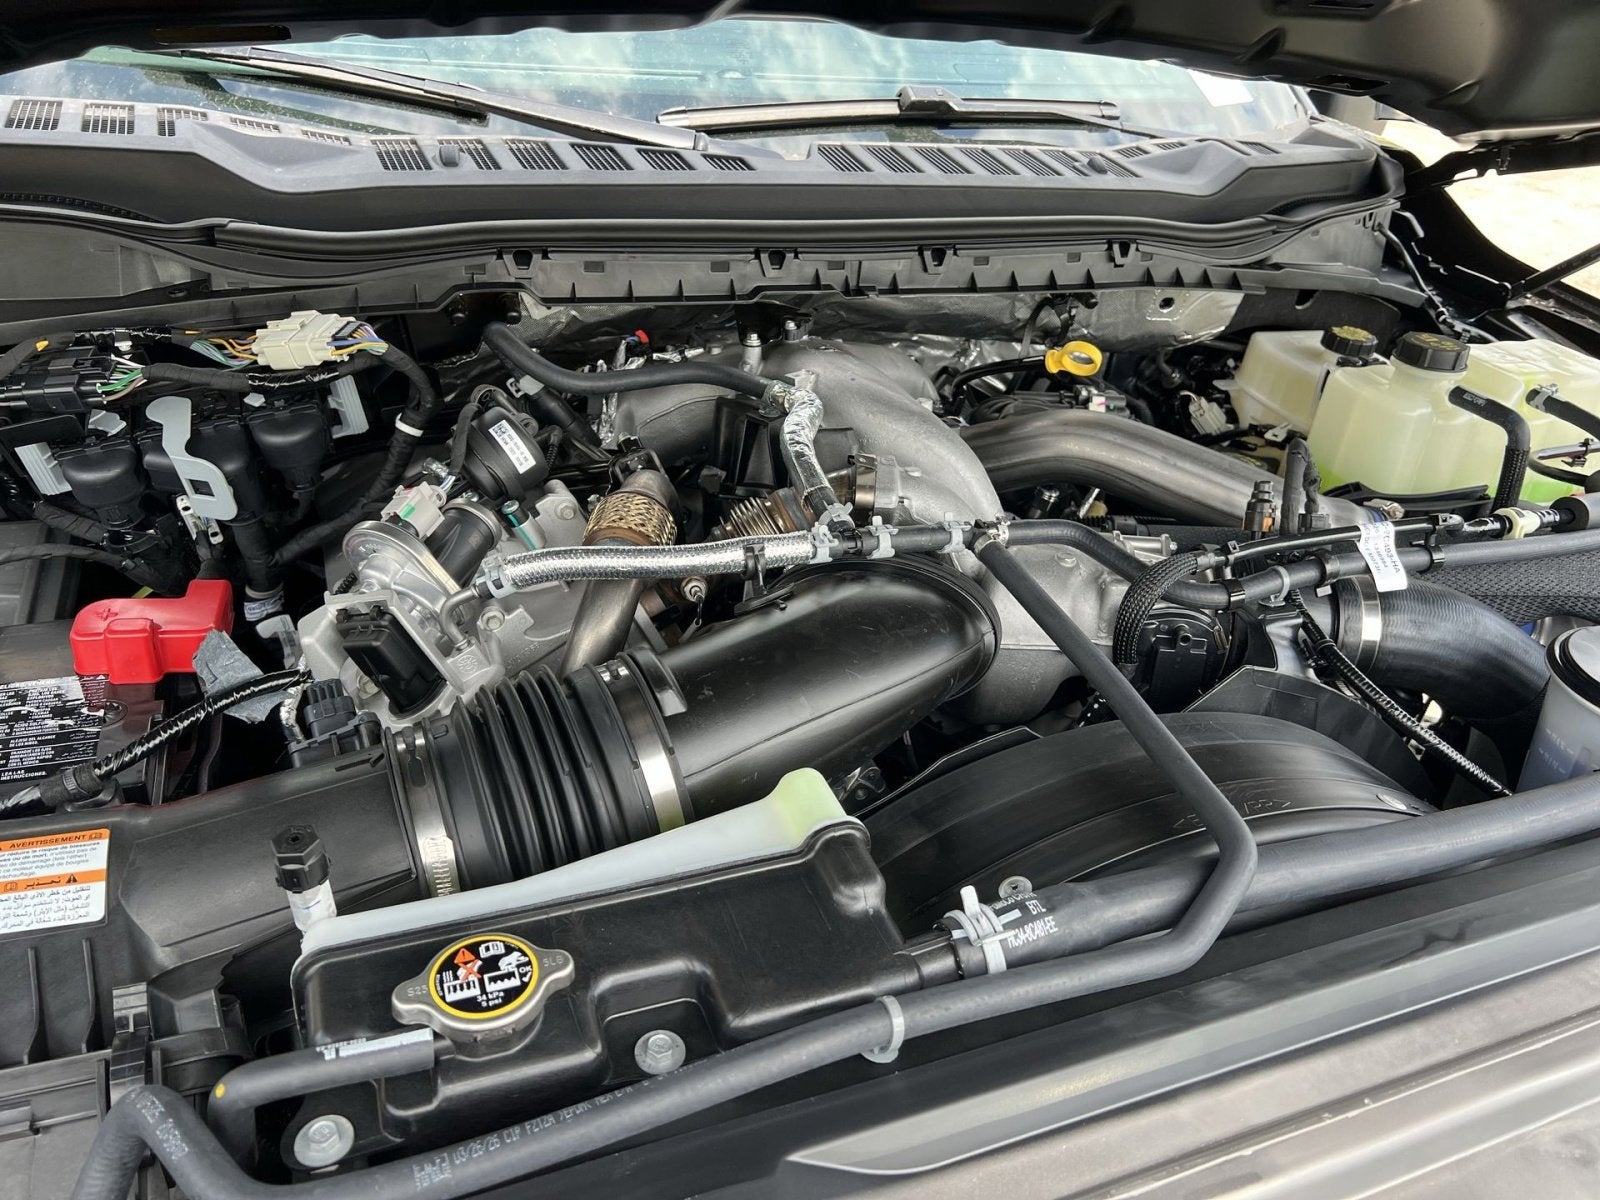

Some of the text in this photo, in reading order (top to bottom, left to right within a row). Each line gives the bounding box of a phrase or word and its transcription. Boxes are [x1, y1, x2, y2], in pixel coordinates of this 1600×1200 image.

[9, 834, 87, 849] AVERTISSEMENT
[1026, 900, 1047, 915] BTL
[519, 965, 533, 974] OK
[476, 991, 505, 1002] 34 kPa
[489, 998, 502, 1007] psi
